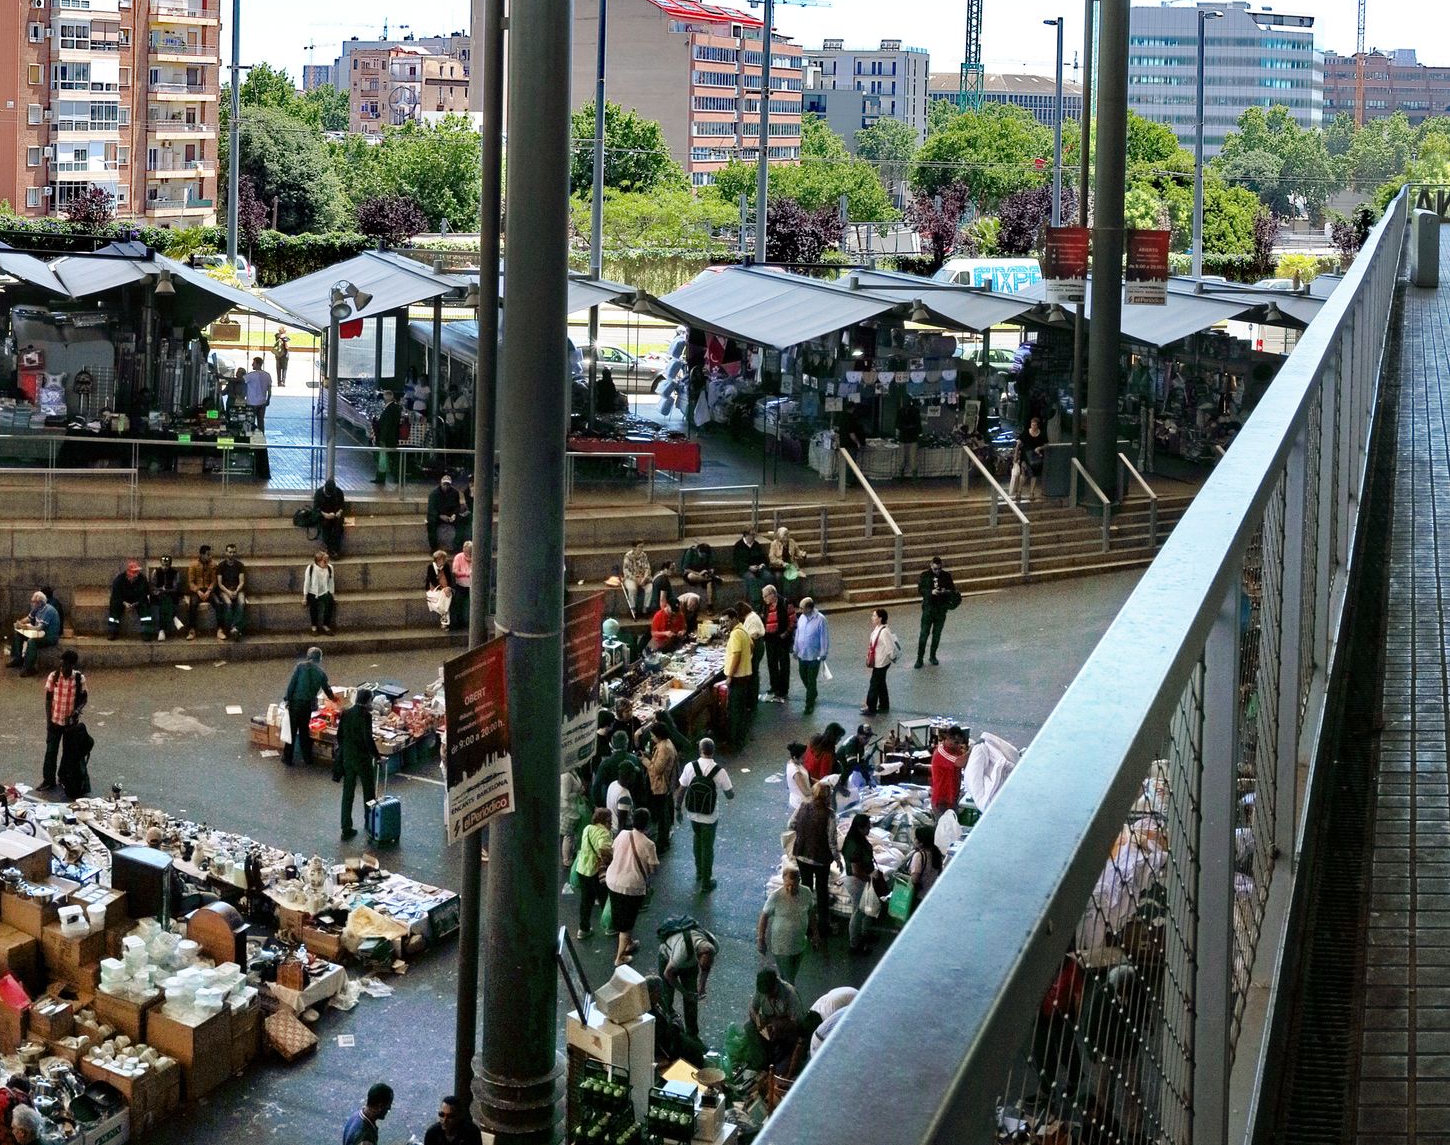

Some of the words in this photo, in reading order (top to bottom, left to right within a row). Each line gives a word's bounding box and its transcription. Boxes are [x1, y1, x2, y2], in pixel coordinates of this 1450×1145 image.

[464, 687, 487, 706] OBERT
[451, 744, 459, 755] de
[459, 734, 475, 750] 9:00
[475, 733, 480, 741] a
[481, 721, 498, 738] 20:00
[451, 797, 475, 815] ENCANTS
[476, 778, 509, 801] BARCELONA
